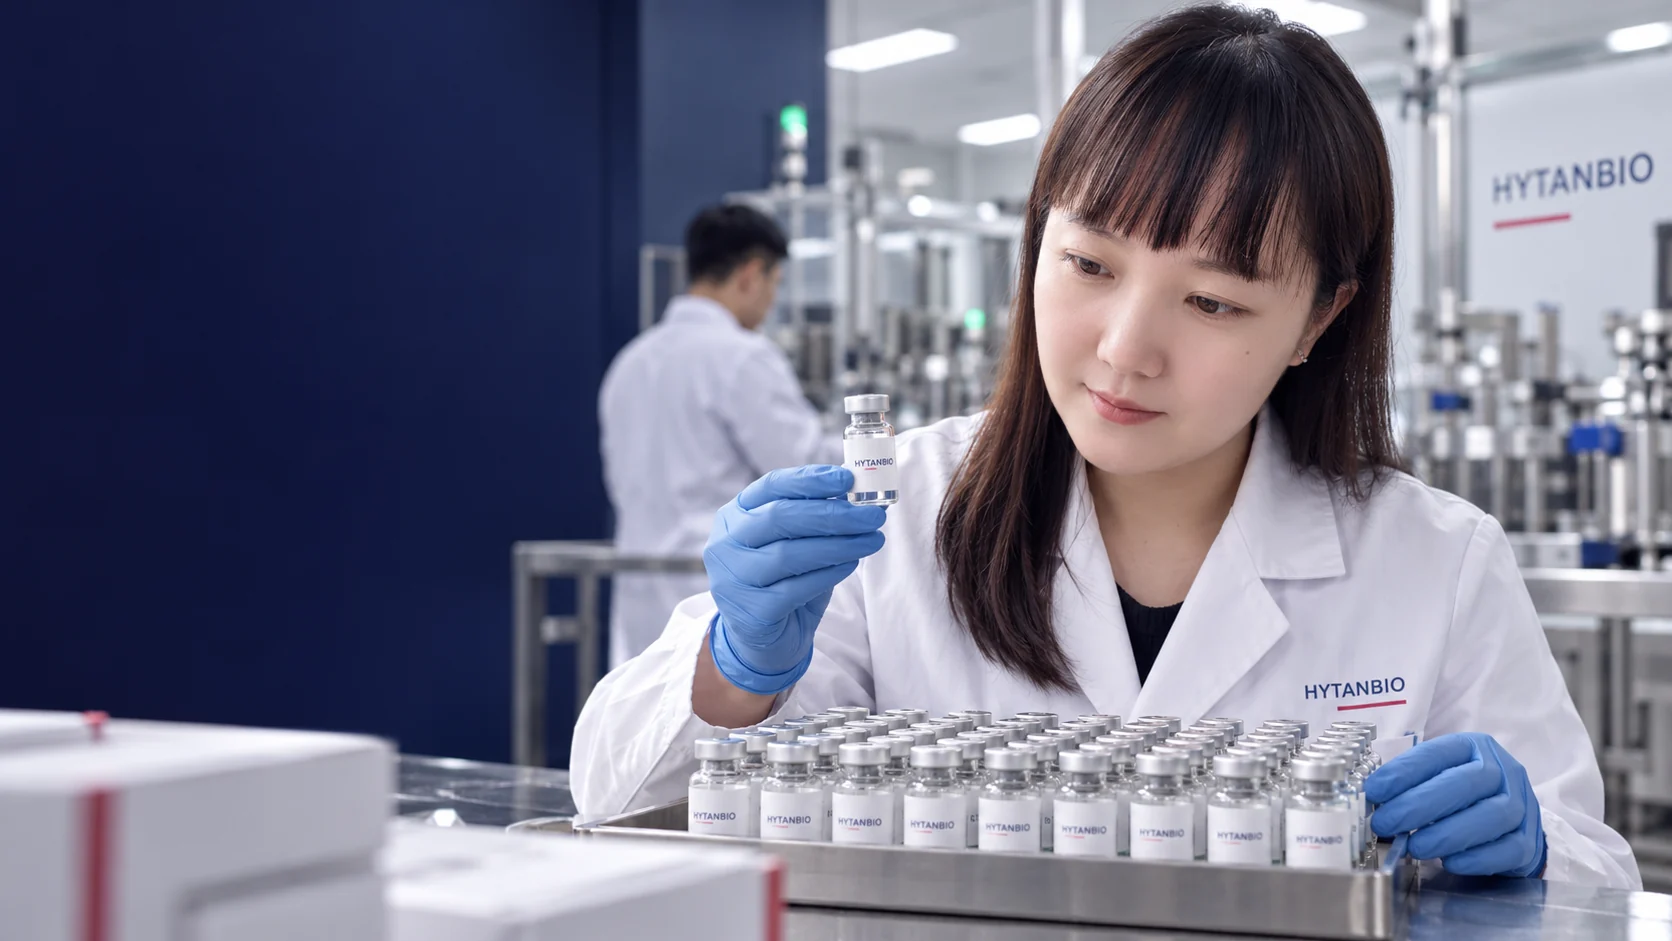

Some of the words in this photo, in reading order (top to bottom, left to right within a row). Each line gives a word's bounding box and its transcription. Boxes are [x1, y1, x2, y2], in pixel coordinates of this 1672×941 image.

[1493, 152, 1654, 204] HYTANBIO
[854, 458, 894, 467] HYTANBIO
[1304, 677, 1405, 699] HYTANBIO
[693, 812, 736, 820] HYTANBIO
[767, 815, 811, 824] HYTANBIO
[838, 817, 882, 826] HYTANBIO
[910, 820, 955, 829] HYTANBIO
[985, 823, 1030, 832] HYTANBIO
[1062, 825, 1107, 834] HYTANBIO
[1139, 829, 1185, 838] HYTANBIO
[1217, 832, 1263, 841] HYTANBIO
[1296, 836, 1343, 845] HYTANBIO
